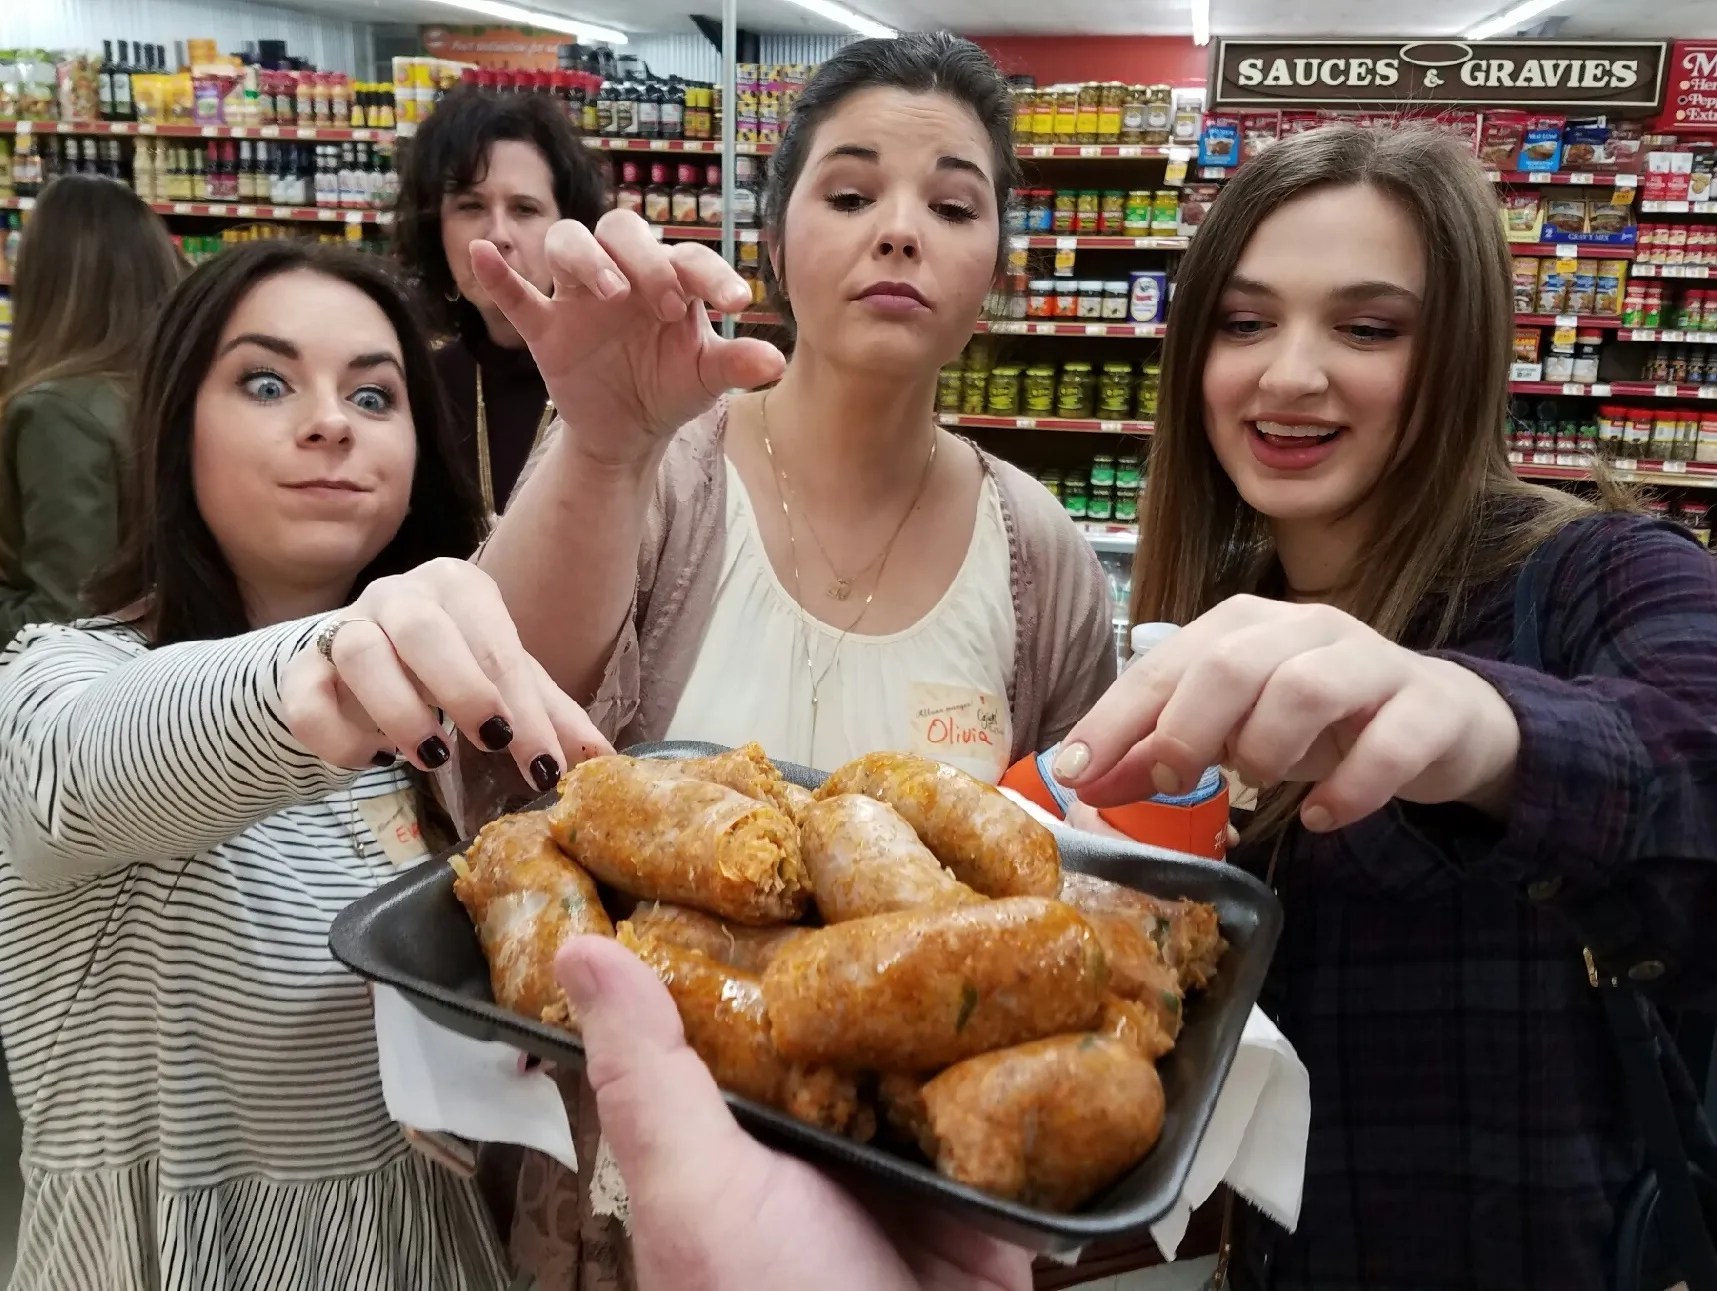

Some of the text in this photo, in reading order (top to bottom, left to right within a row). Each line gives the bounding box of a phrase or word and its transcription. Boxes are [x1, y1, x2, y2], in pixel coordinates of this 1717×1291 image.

[1238, 58, 1638, 88] SAUCES & GRAVIES
[927, 716, 993, 745] Olivia
